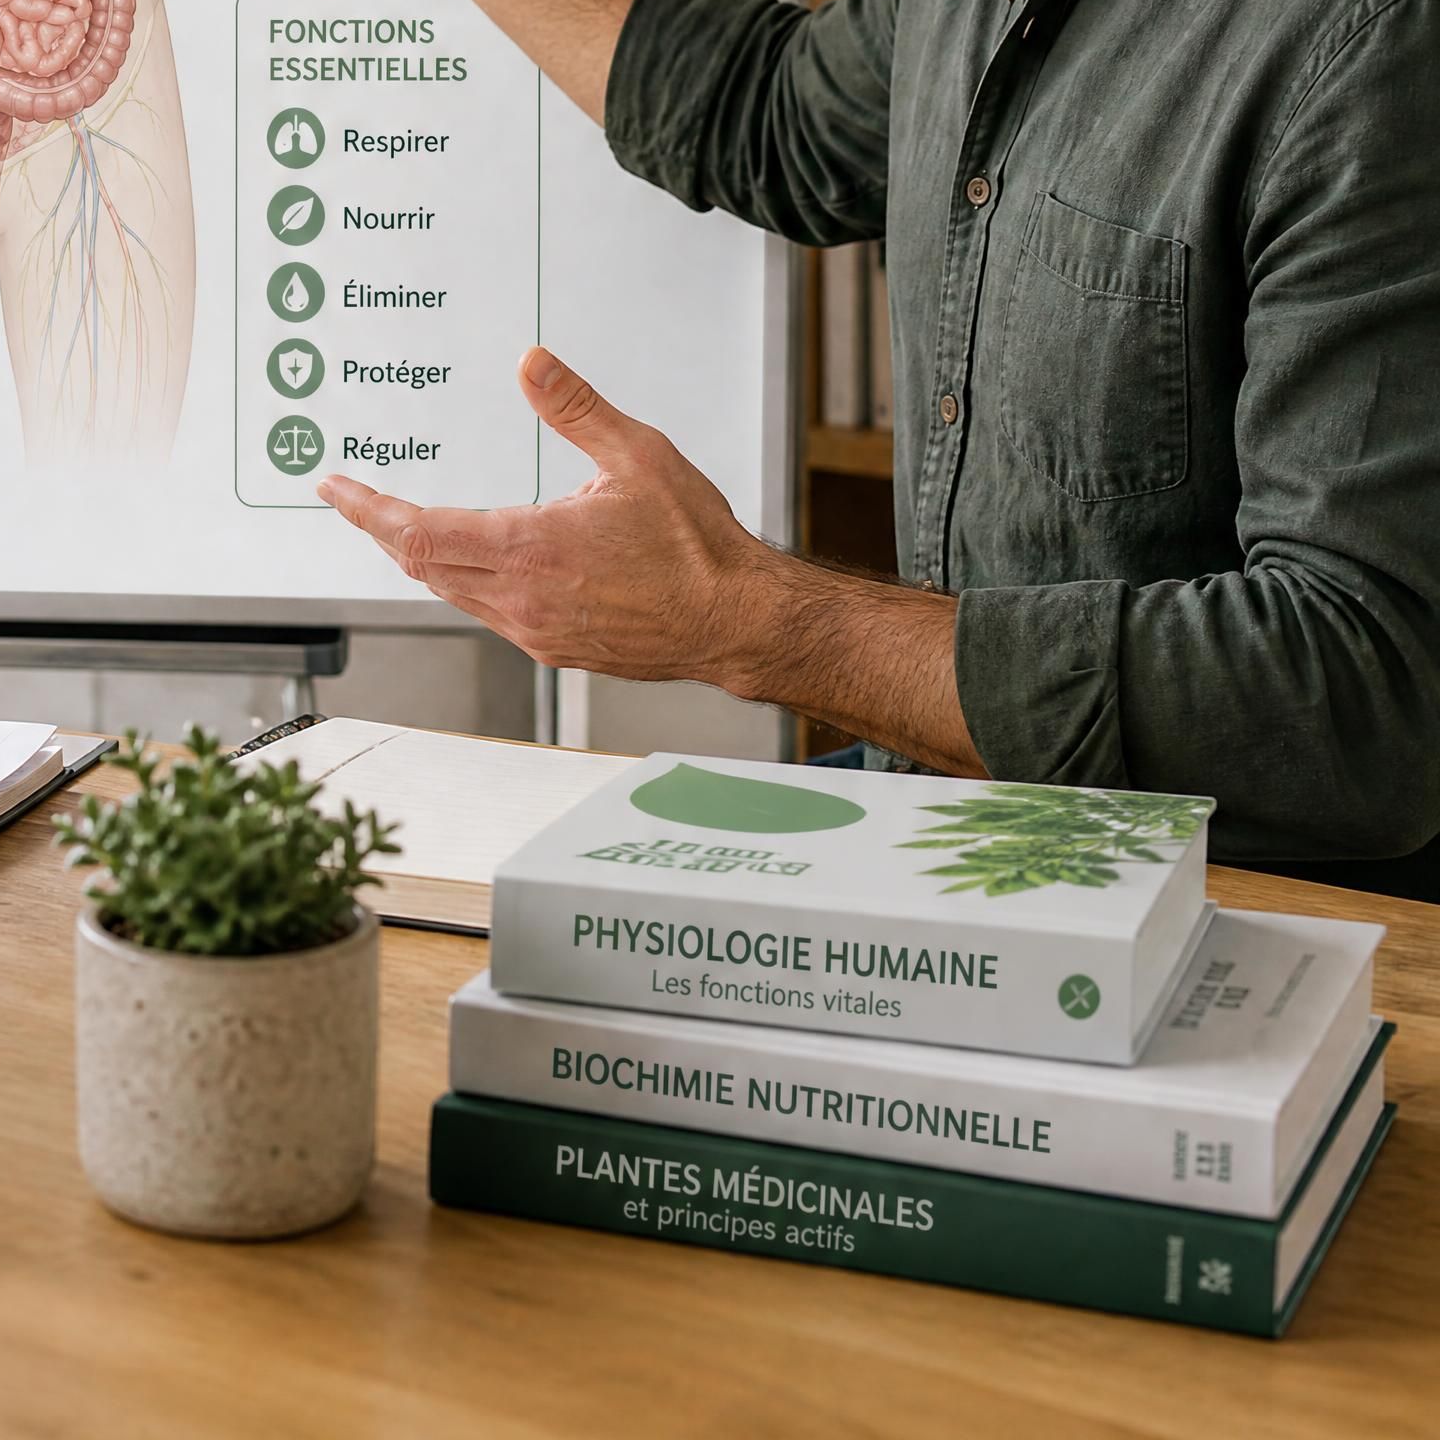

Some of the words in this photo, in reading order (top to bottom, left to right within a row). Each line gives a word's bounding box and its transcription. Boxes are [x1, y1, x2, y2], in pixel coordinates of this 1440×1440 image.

[270, 20, 434, 43] FONCTIONS
[270, 57, 467, 81] ESSENTIELLES
[345, 129, 449, 158] Respirer
[344, 207, 435, 229] Nourrir
[344, 279, 447, 308] Éliminer
[344, 360, 451, 389] Protéger
[344, 437, 440, 466] Réguler
[574, 914, 811, 971] PHYSIOLOGIE
[826, 940, 998, 989] HUMAINE
[653, 970, 691, 995] Les
[700, 973, 814, 1009] fonctions
[823, 991, 901, 1017] vitales
[552, 1048, 734, 1105] BIOCHIMIE
[748, 1078, 1051, 1153] NUTRITIONNELLE
[557, 1145, 701, 1195] PLANTES
[711, 1165, 935, 1233] MÉDICINALES
[624, 1198, 648, 1221] et
[658, 1206, 776, 1241] principes
[785, 1224, 854, 1252] actifs
